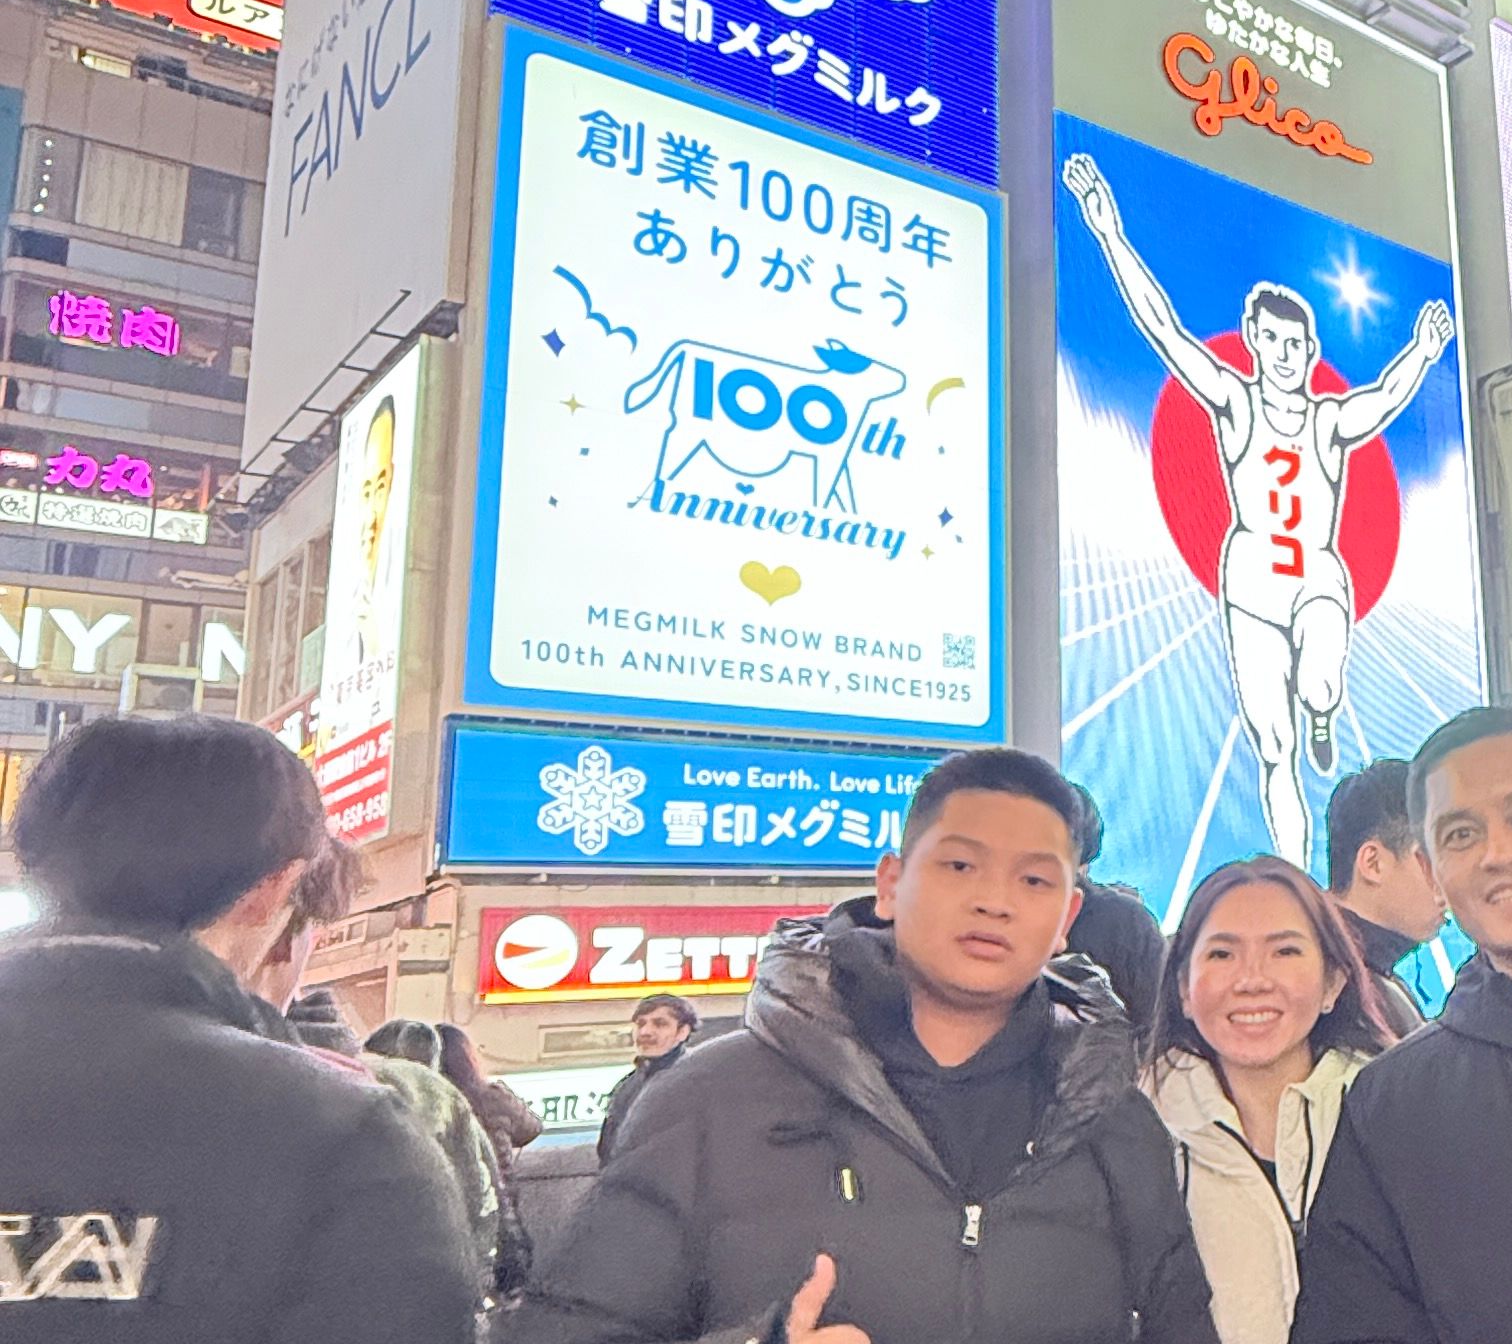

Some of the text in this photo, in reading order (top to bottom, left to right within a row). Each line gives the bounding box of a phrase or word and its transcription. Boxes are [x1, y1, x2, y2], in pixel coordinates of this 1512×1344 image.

[1163, 32, 1373, 165] Glico
[576, 109, 952, 268] 創業100周年
[632, 209, 908, 326] ありがとう
[47, 289, 181, 357] 焼肉
[628, 477, 907, 560] Anniversary
[1262, 443, 1305, 577] グリコ
[521, 640, 605, 669] 100th
[588, 604, 922, 663] MEGMILK SNOW BRAND
[683, 763, 740, 788] Love
[748, 767, 821, 791] Earth.
[830, 770, 881, 794] Love
